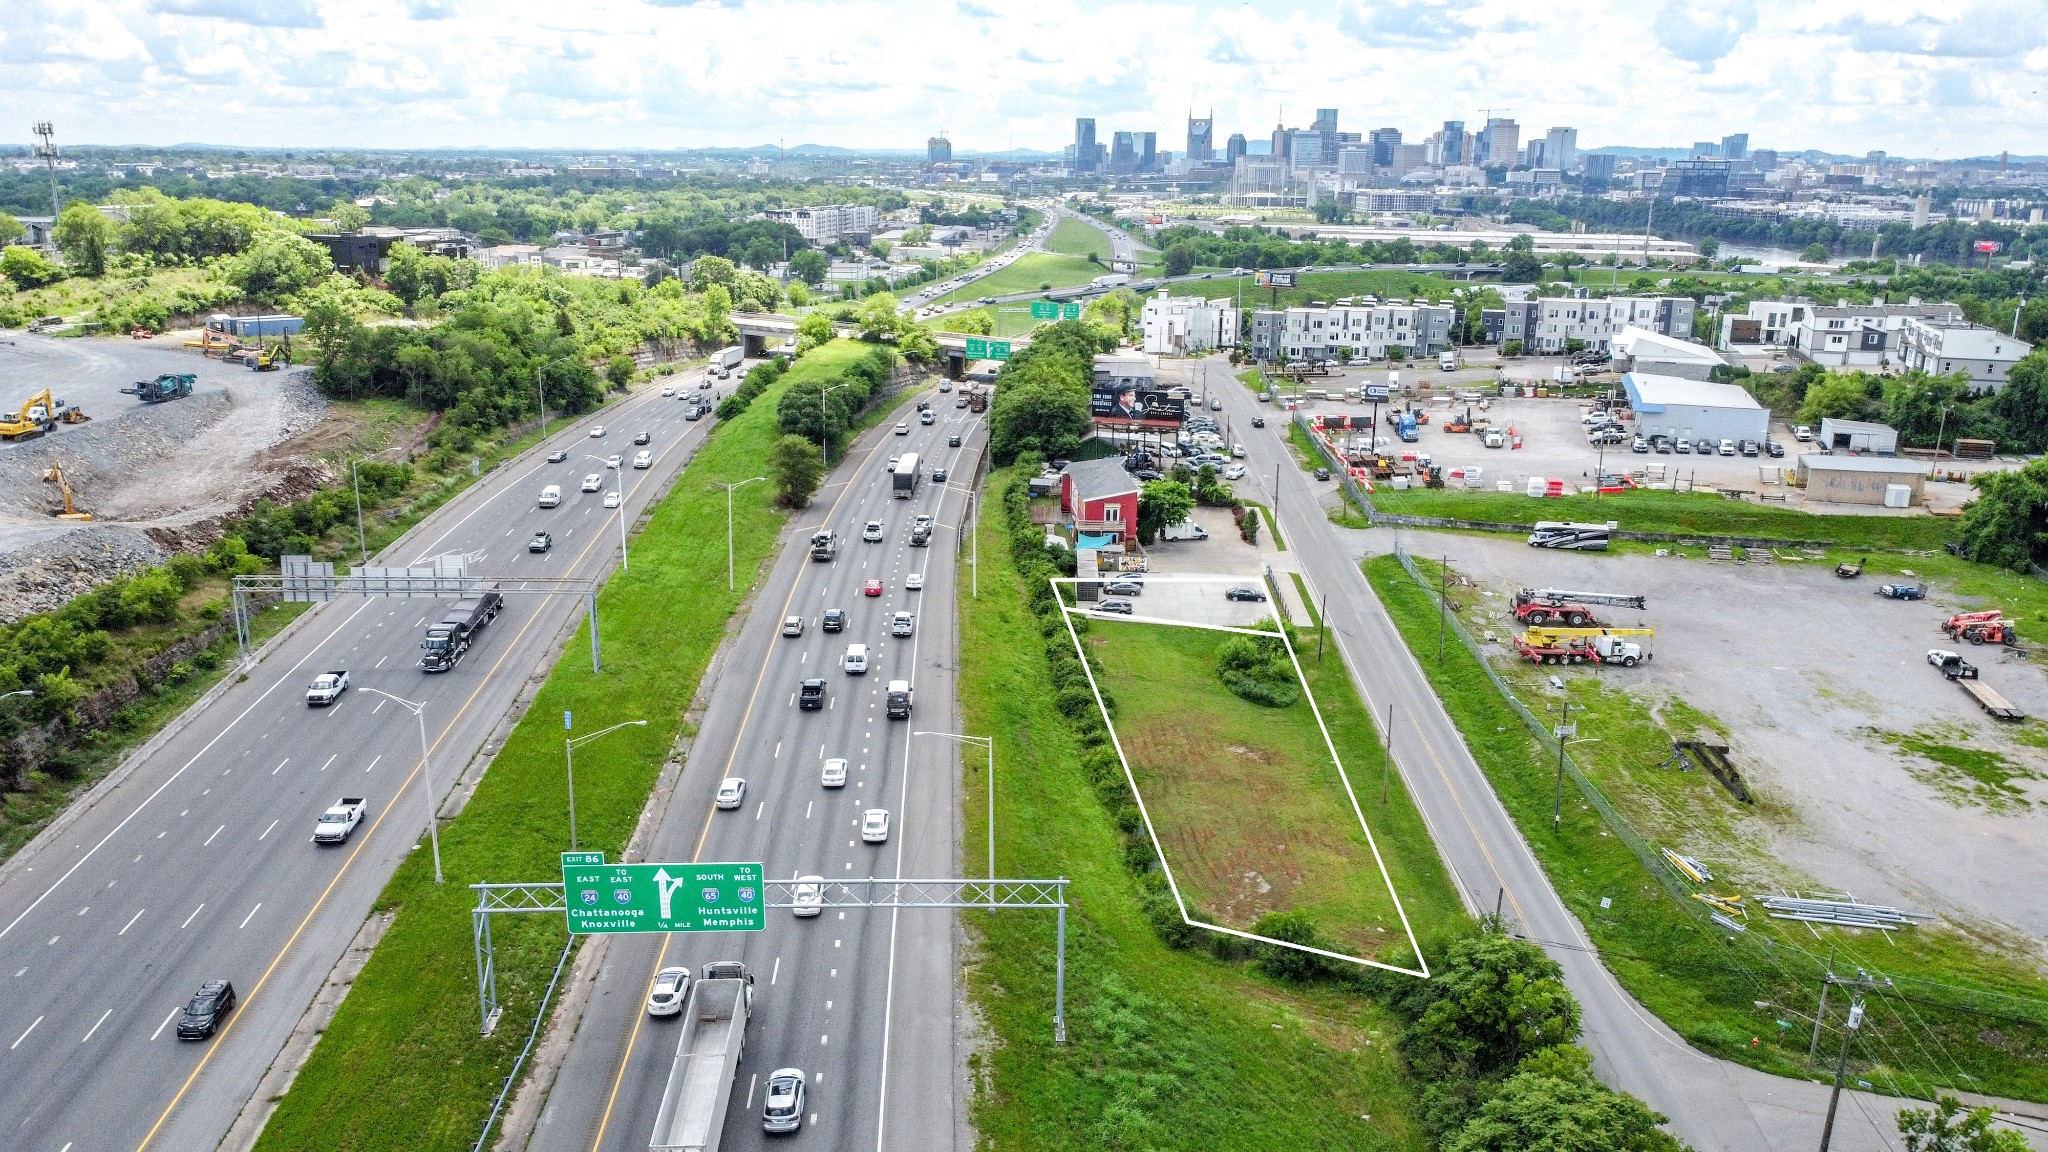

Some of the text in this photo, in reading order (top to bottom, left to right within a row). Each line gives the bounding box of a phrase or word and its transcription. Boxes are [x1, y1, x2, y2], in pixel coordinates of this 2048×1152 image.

[585, 855, 599, 863] 86
[576, 875, 600, 883] EAST
[584, 894, 596, 902] 24
[617, 893, 629, 901] 40
[705, 892, 716, 900] 65
[740, 891, 753, 899] 40
[571, 908, 645, 918] Chattanooga
[698, 906, 758, 914] Huntsville
[581, 920, 636, 928] Knoxville
[703, 918, 754, 927] Memphis
